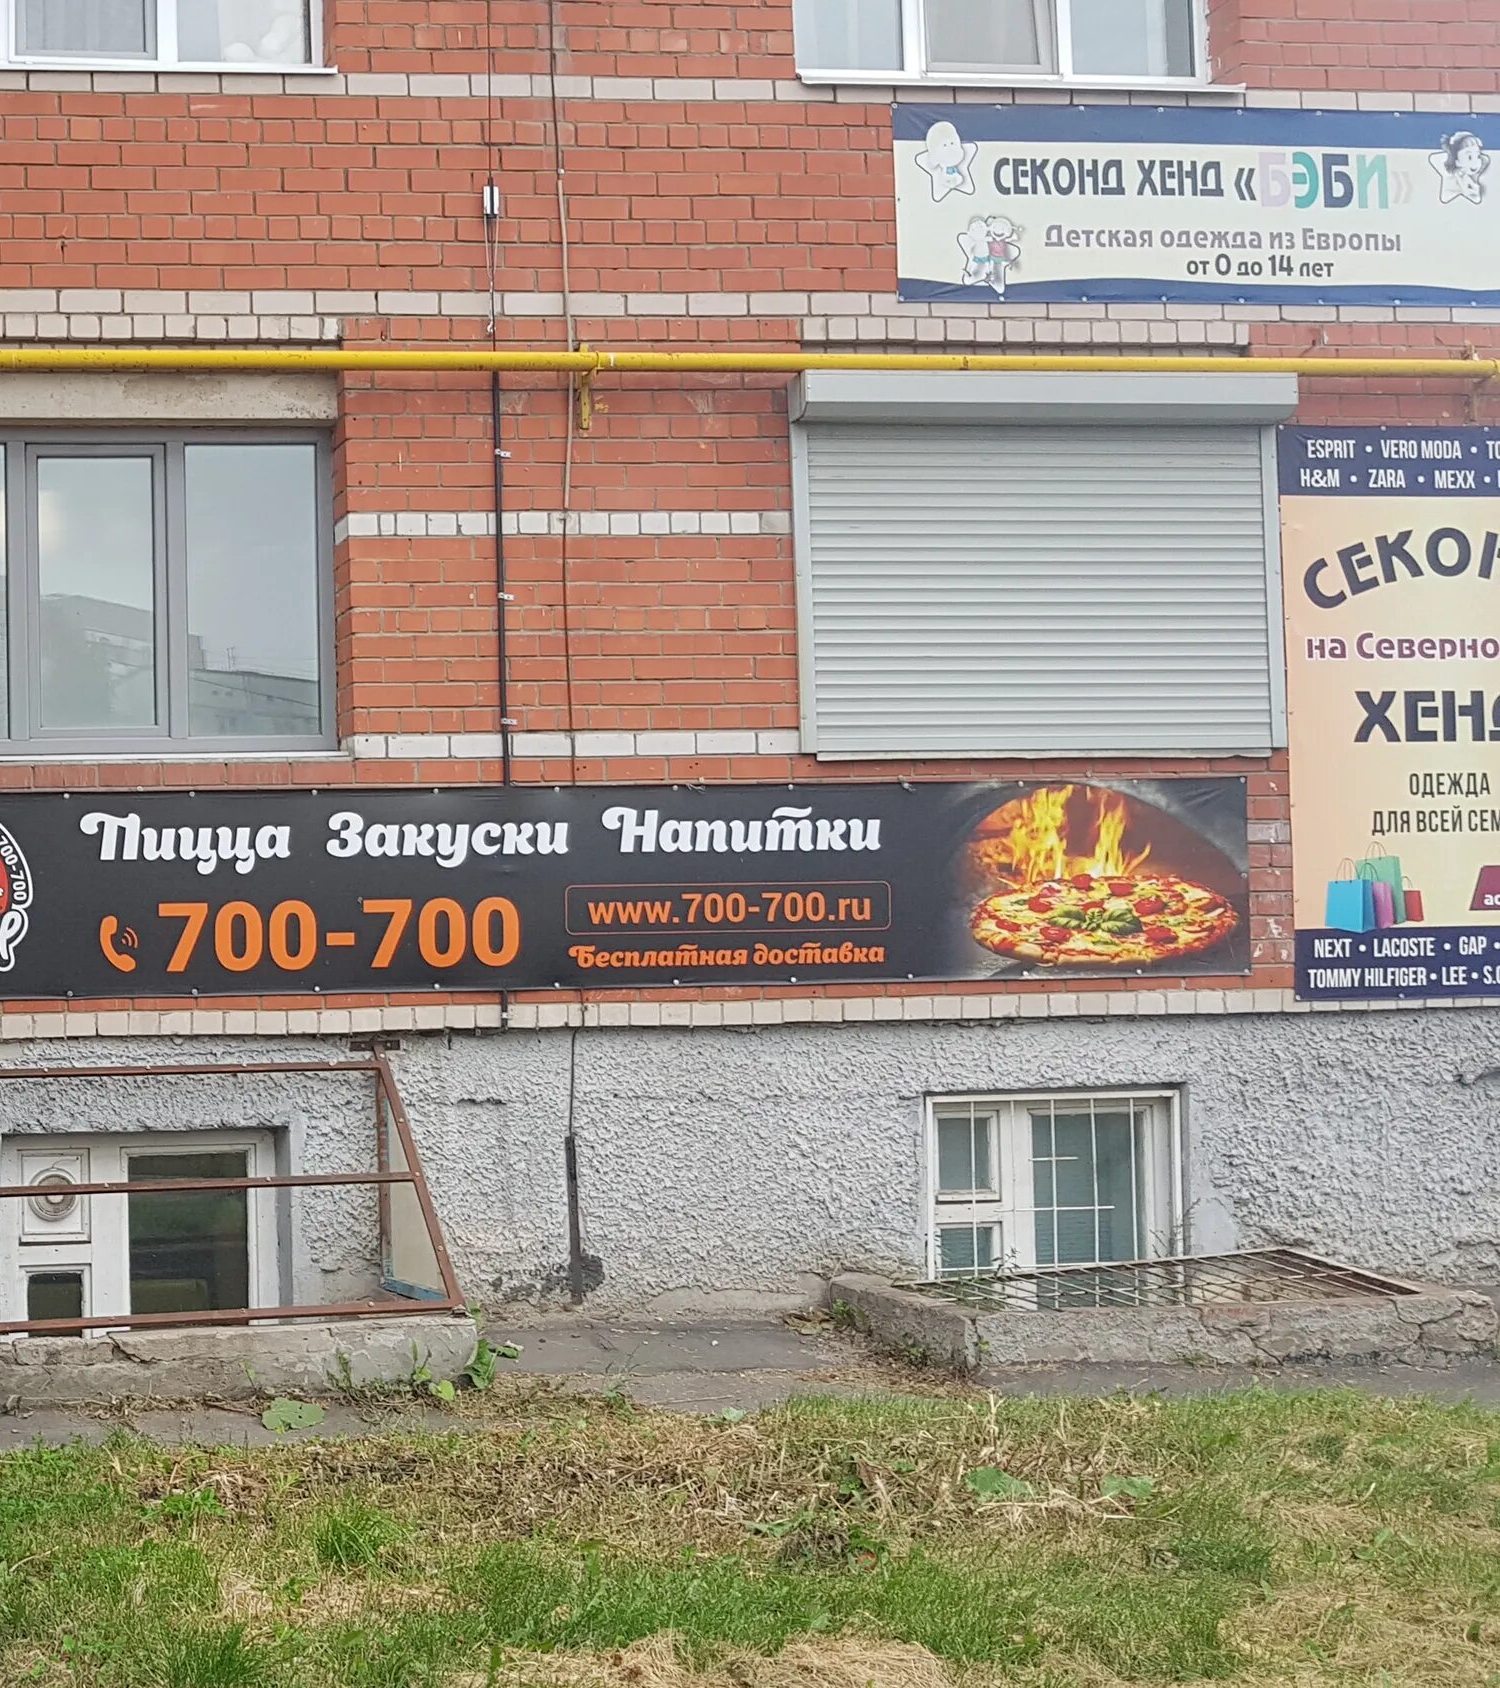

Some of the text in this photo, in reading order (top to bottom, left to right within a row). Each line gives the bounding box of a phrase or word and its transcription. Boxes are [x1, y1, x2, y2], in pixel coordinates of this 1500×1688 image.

[994, 157, 1126, 196] СЕКОНД
[1137, 159, 1224, 197] ХЕНД
[1045, 224, 1401, 251] Детская одежда из Европы
[1186, 253, 1334, 277] от 0 до 14 лет
[1307, 440, 1356, 458] ESPRIT
[1380, 440, 1418, 458] VERO
[1421, 440, 1462, 459] MODA
[1300, 469, 1340, 487] H&M
[1368, 469, 1406, 488] ZARA
[1434, 470, 1476, 489] MEXX
[1306, 637, 1347, 659] на
[1354, 690, 1500, 742] ХЕН
[1409, 772, 1491, 798] ОДЕЖДА
[1372, 810, 1410, 835] ДЛЯ
[1416, 805, 1463, 833] ВСЕЙ
[79, 806, 881, 876] Пицца Закуски Напитки
[587, 891, 872, 925] www.700-700.ru
[157, 897, 520, 973] 700-700
[1314, 935, 1487, 958] NEXT LACOSTE GAP
[568, 941, 885, 969] Бесплатная доставка
[1308, 968, 1361, 988] TOMMY
[1364, 967, 1427, 987] HILFIGER
[1441, 966, 1468, 985] LEE
